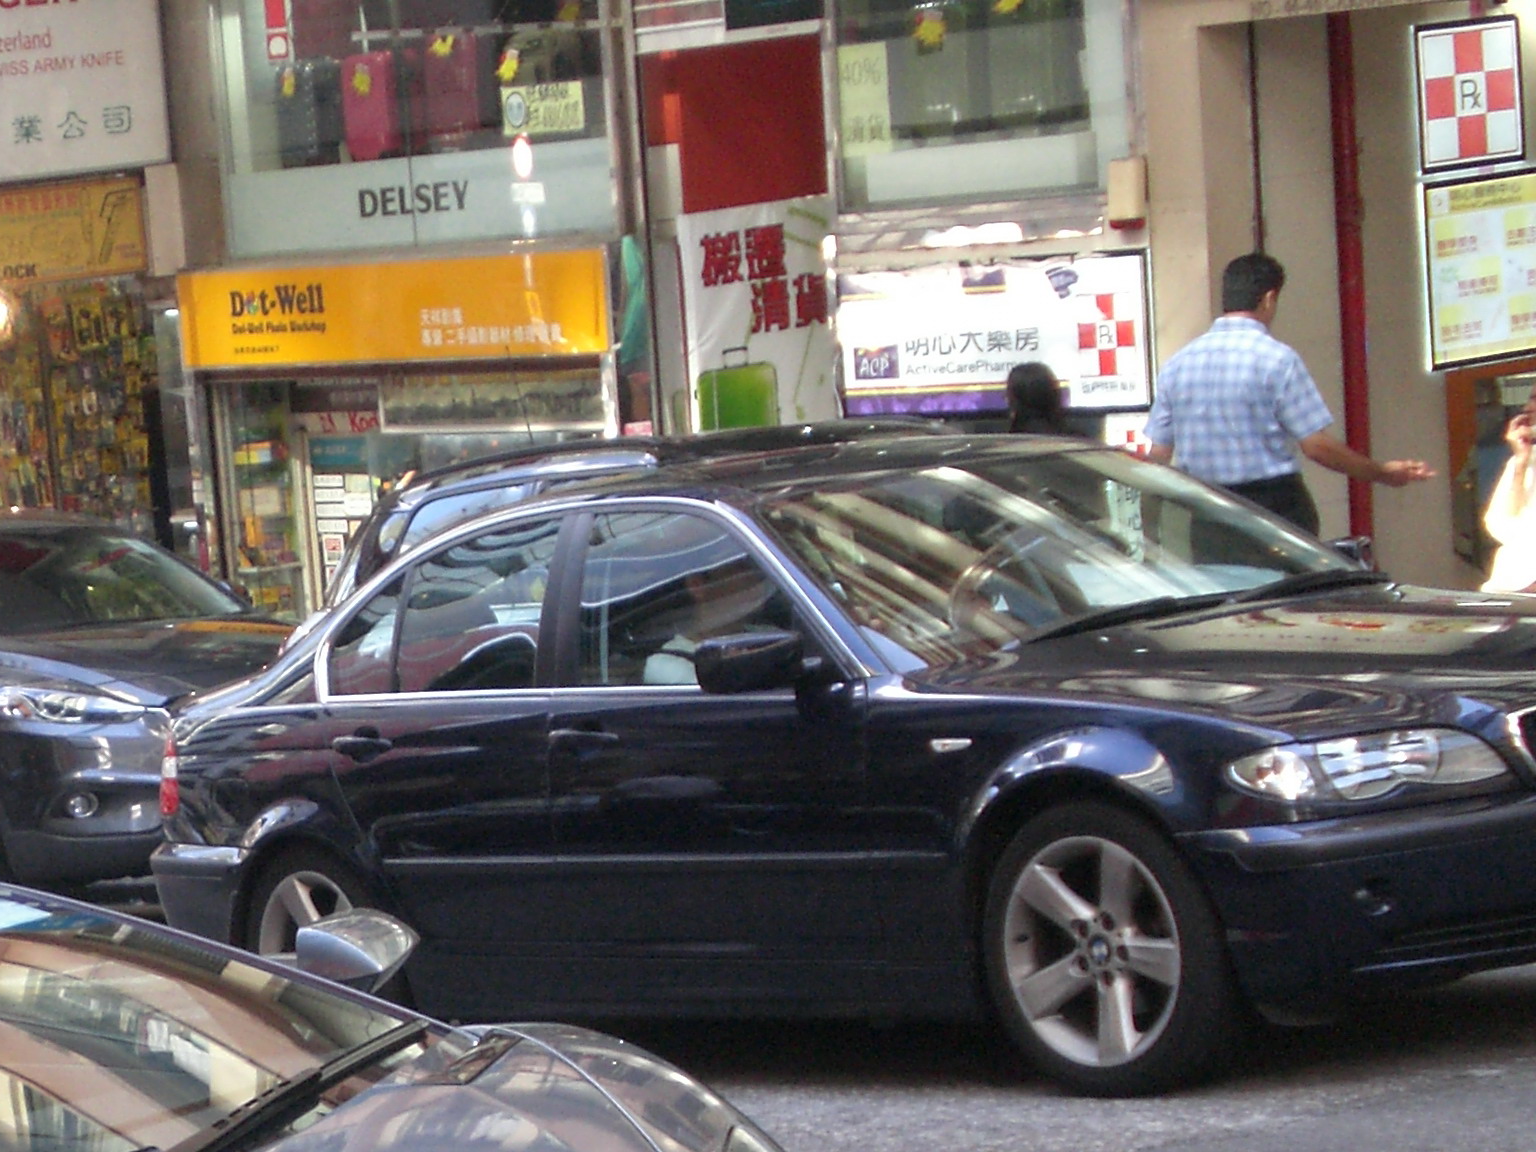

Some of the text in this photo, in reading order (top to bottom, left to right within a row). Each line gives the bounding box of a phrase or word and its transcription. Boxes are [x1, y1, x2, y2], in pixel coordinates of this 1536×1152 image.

[33, 56, 75, 73] ARMY
[81, 51, 125, 68] KNIFE
[358, 180, 470, 219] DELSEY
[700, 223, 787, 287] 搬遷
[751, 273, 828, 334] 清貨
[859, 357, 890, 377] ACP
